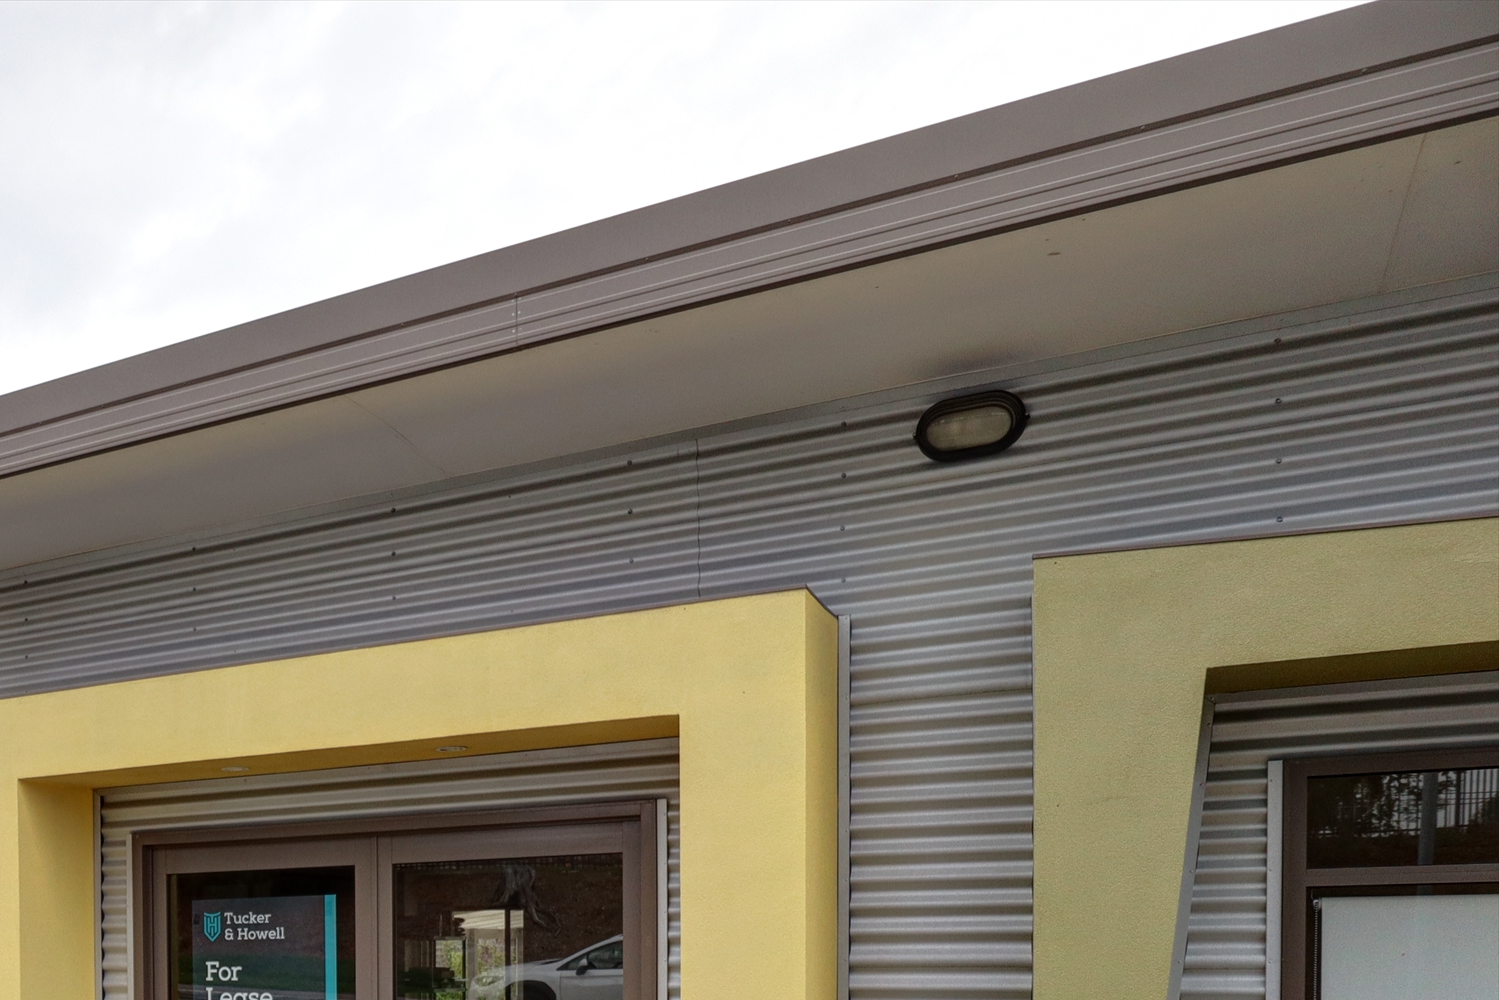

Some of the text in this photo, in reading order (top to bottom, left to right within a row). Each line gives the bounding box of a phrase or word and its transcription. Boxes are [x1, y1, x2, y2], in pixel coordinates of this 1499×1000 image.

[224, 911, 271, 924] Tucker
[224, 927, 285, 940] & Howell
[205, 961, 242, 981] For
